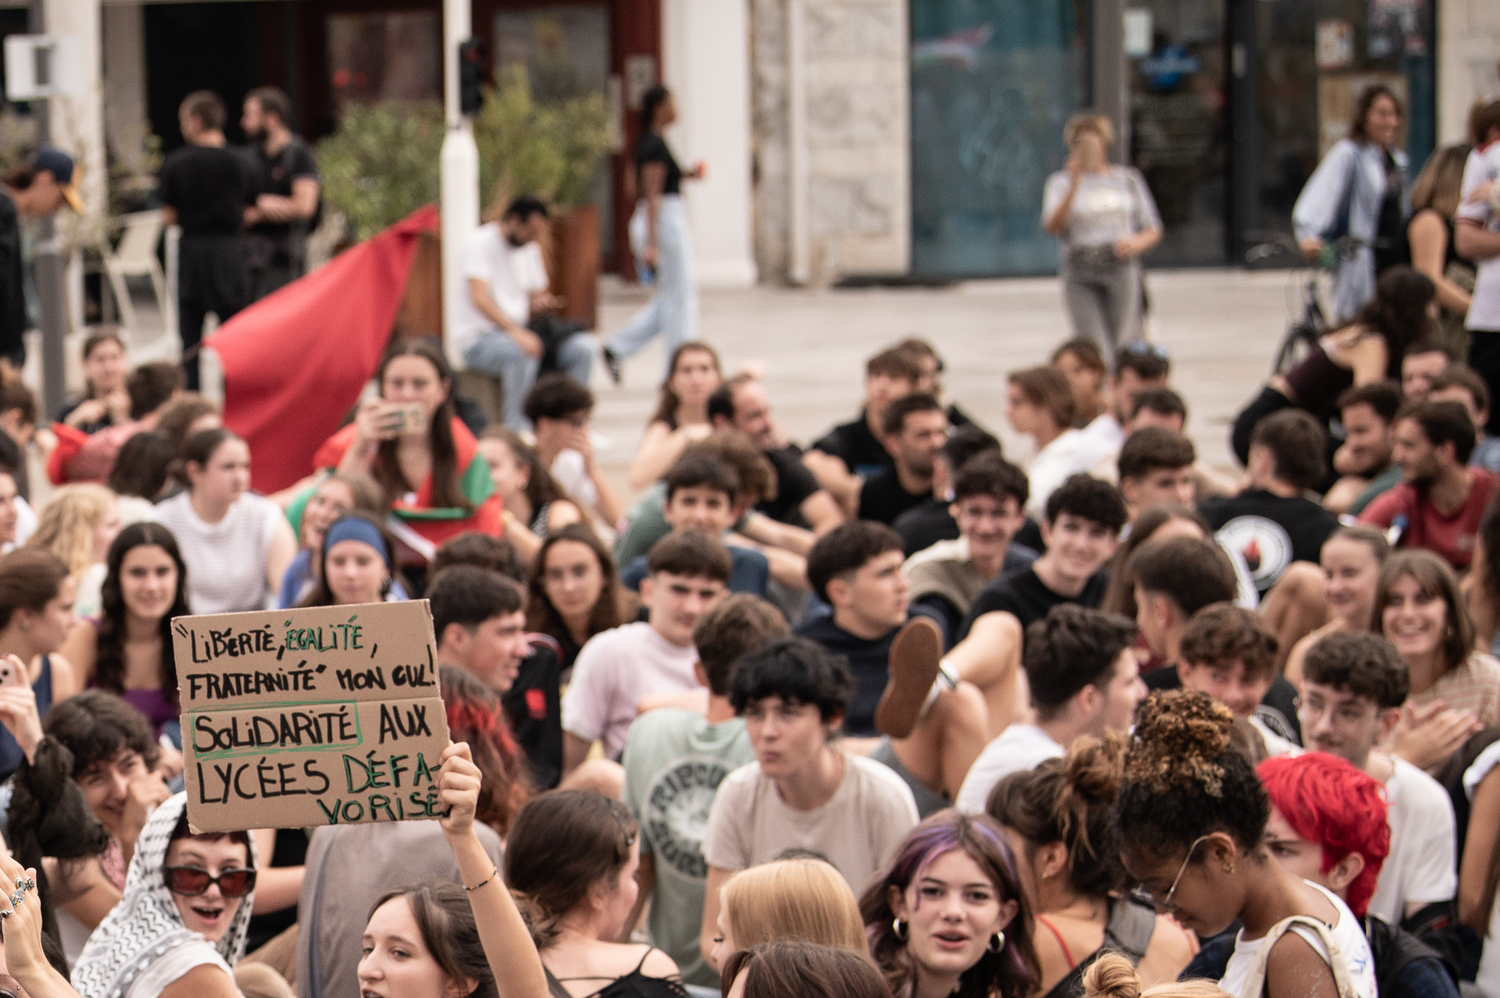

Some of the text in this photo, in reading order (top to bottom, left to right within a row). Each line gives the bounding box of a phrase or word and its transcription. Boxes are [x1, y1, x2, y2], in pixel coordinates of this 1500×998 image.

[336, 666, 387, 692] MON
[378, 703, 432, 744] AUX
[197, 757, 330, 804] LYCÉES
